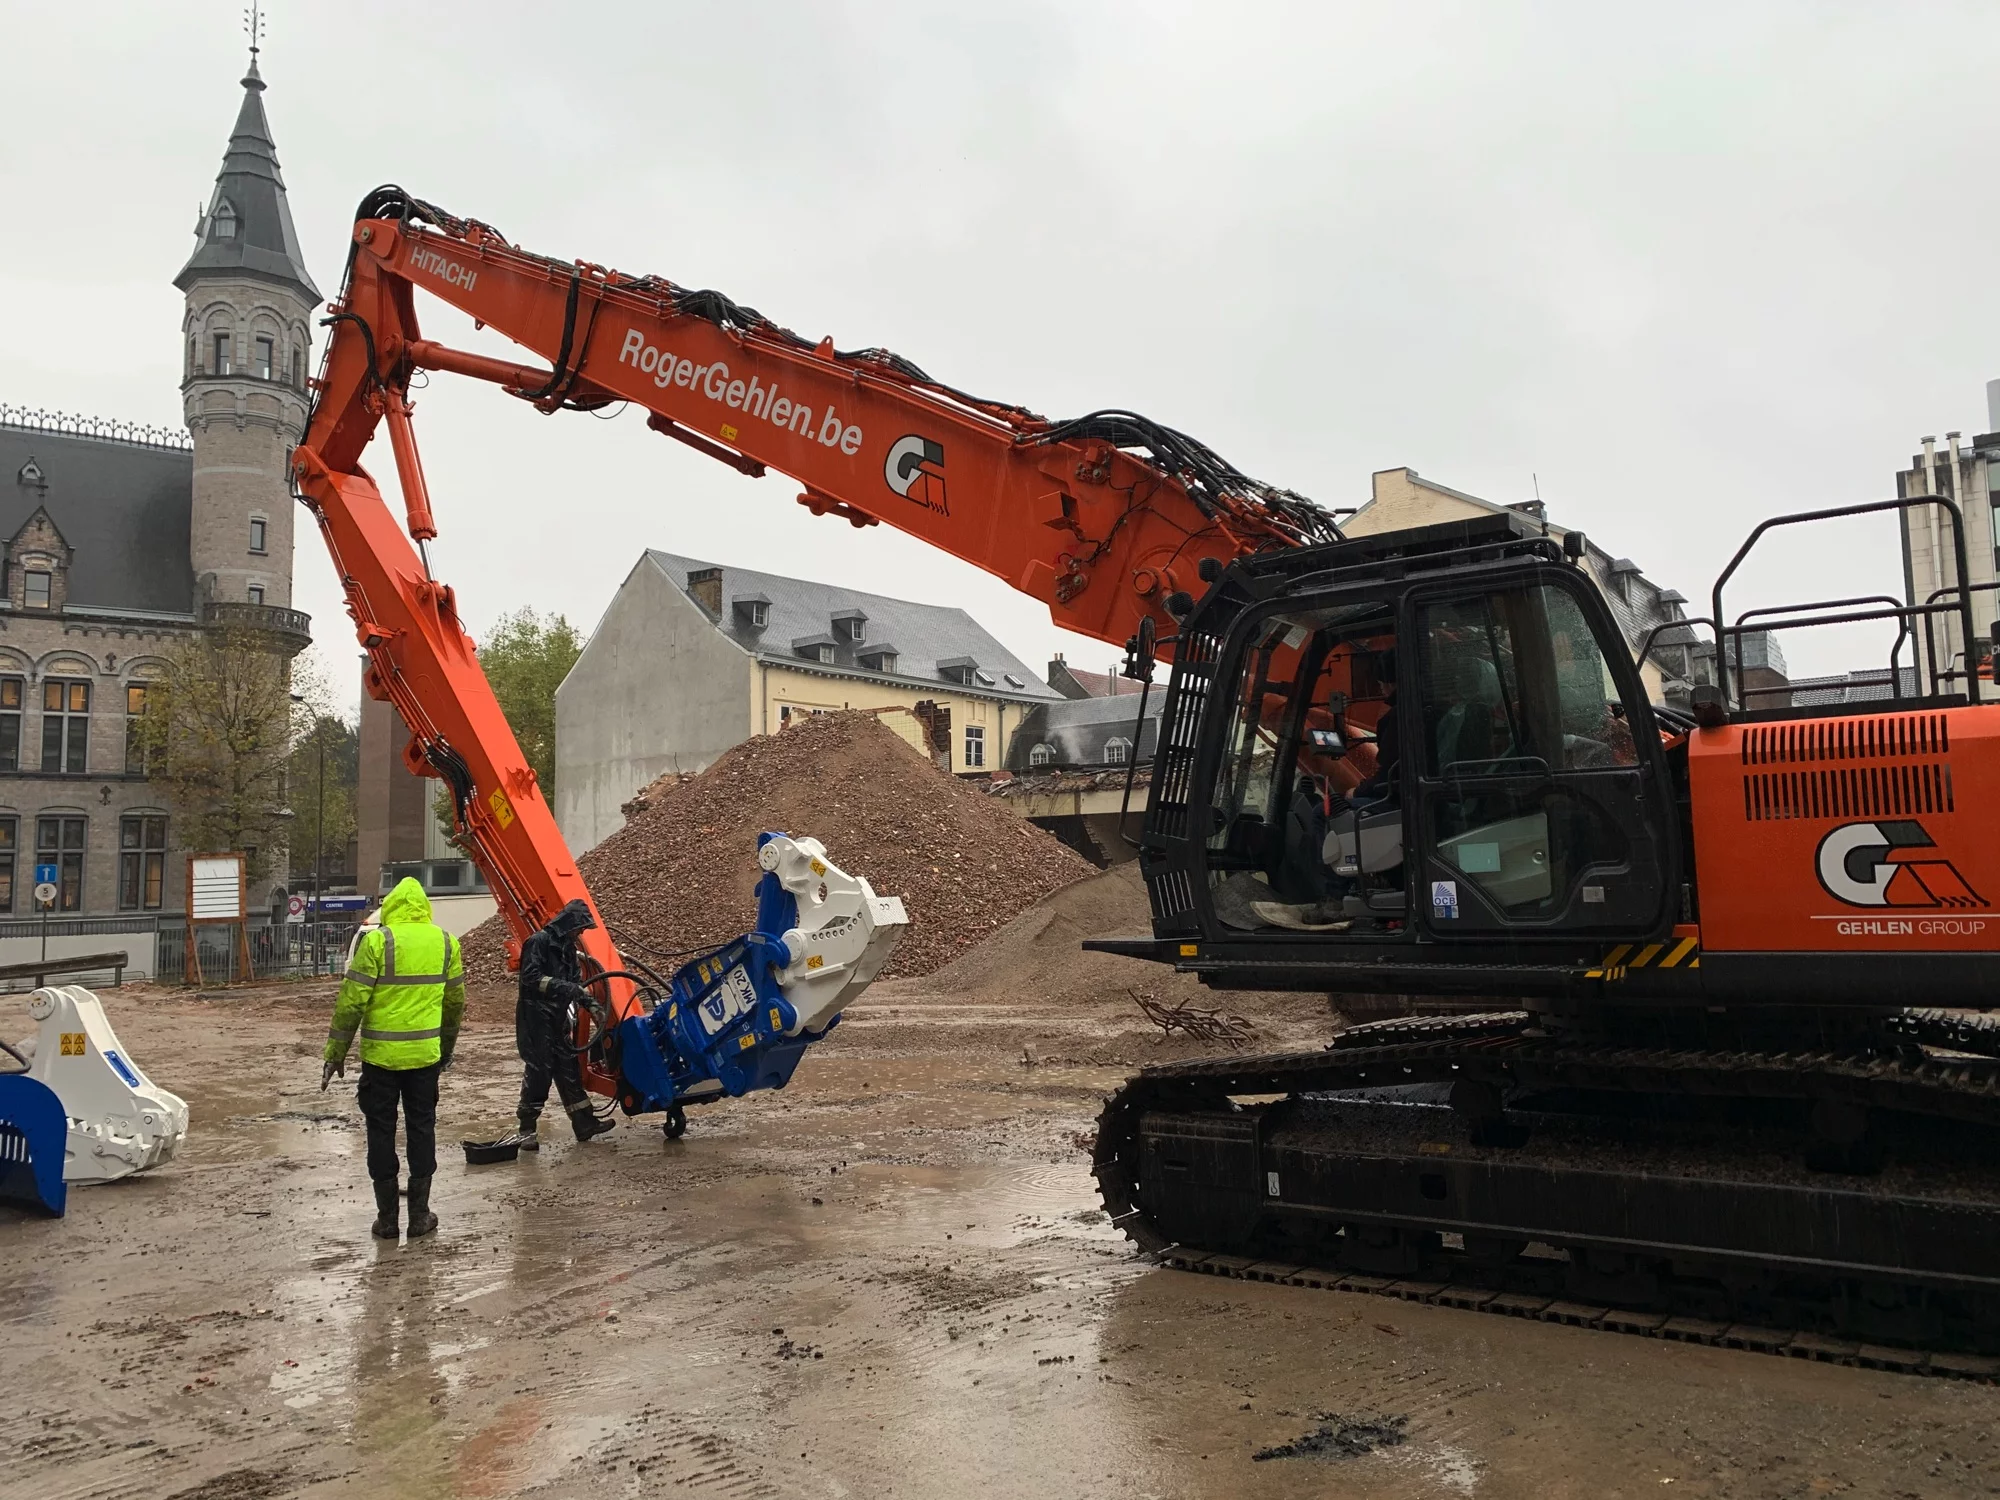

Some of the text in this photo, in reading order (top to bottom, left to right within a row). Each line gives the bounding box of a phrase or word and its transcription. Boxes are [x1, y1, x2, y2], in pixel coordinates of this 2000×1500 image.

[410, 246, 478, 291] HITACHI
[618, 328, 863, 455] RogerGehlen.be
[43, 887, 49, 895] 5
[1434, 897, 1456, 905] OCB
[1837, 921, 1986, 935] GEHLEN GROUP
[733, 969, 747, 985] 20
[740, 984, 756, 1005] MK
